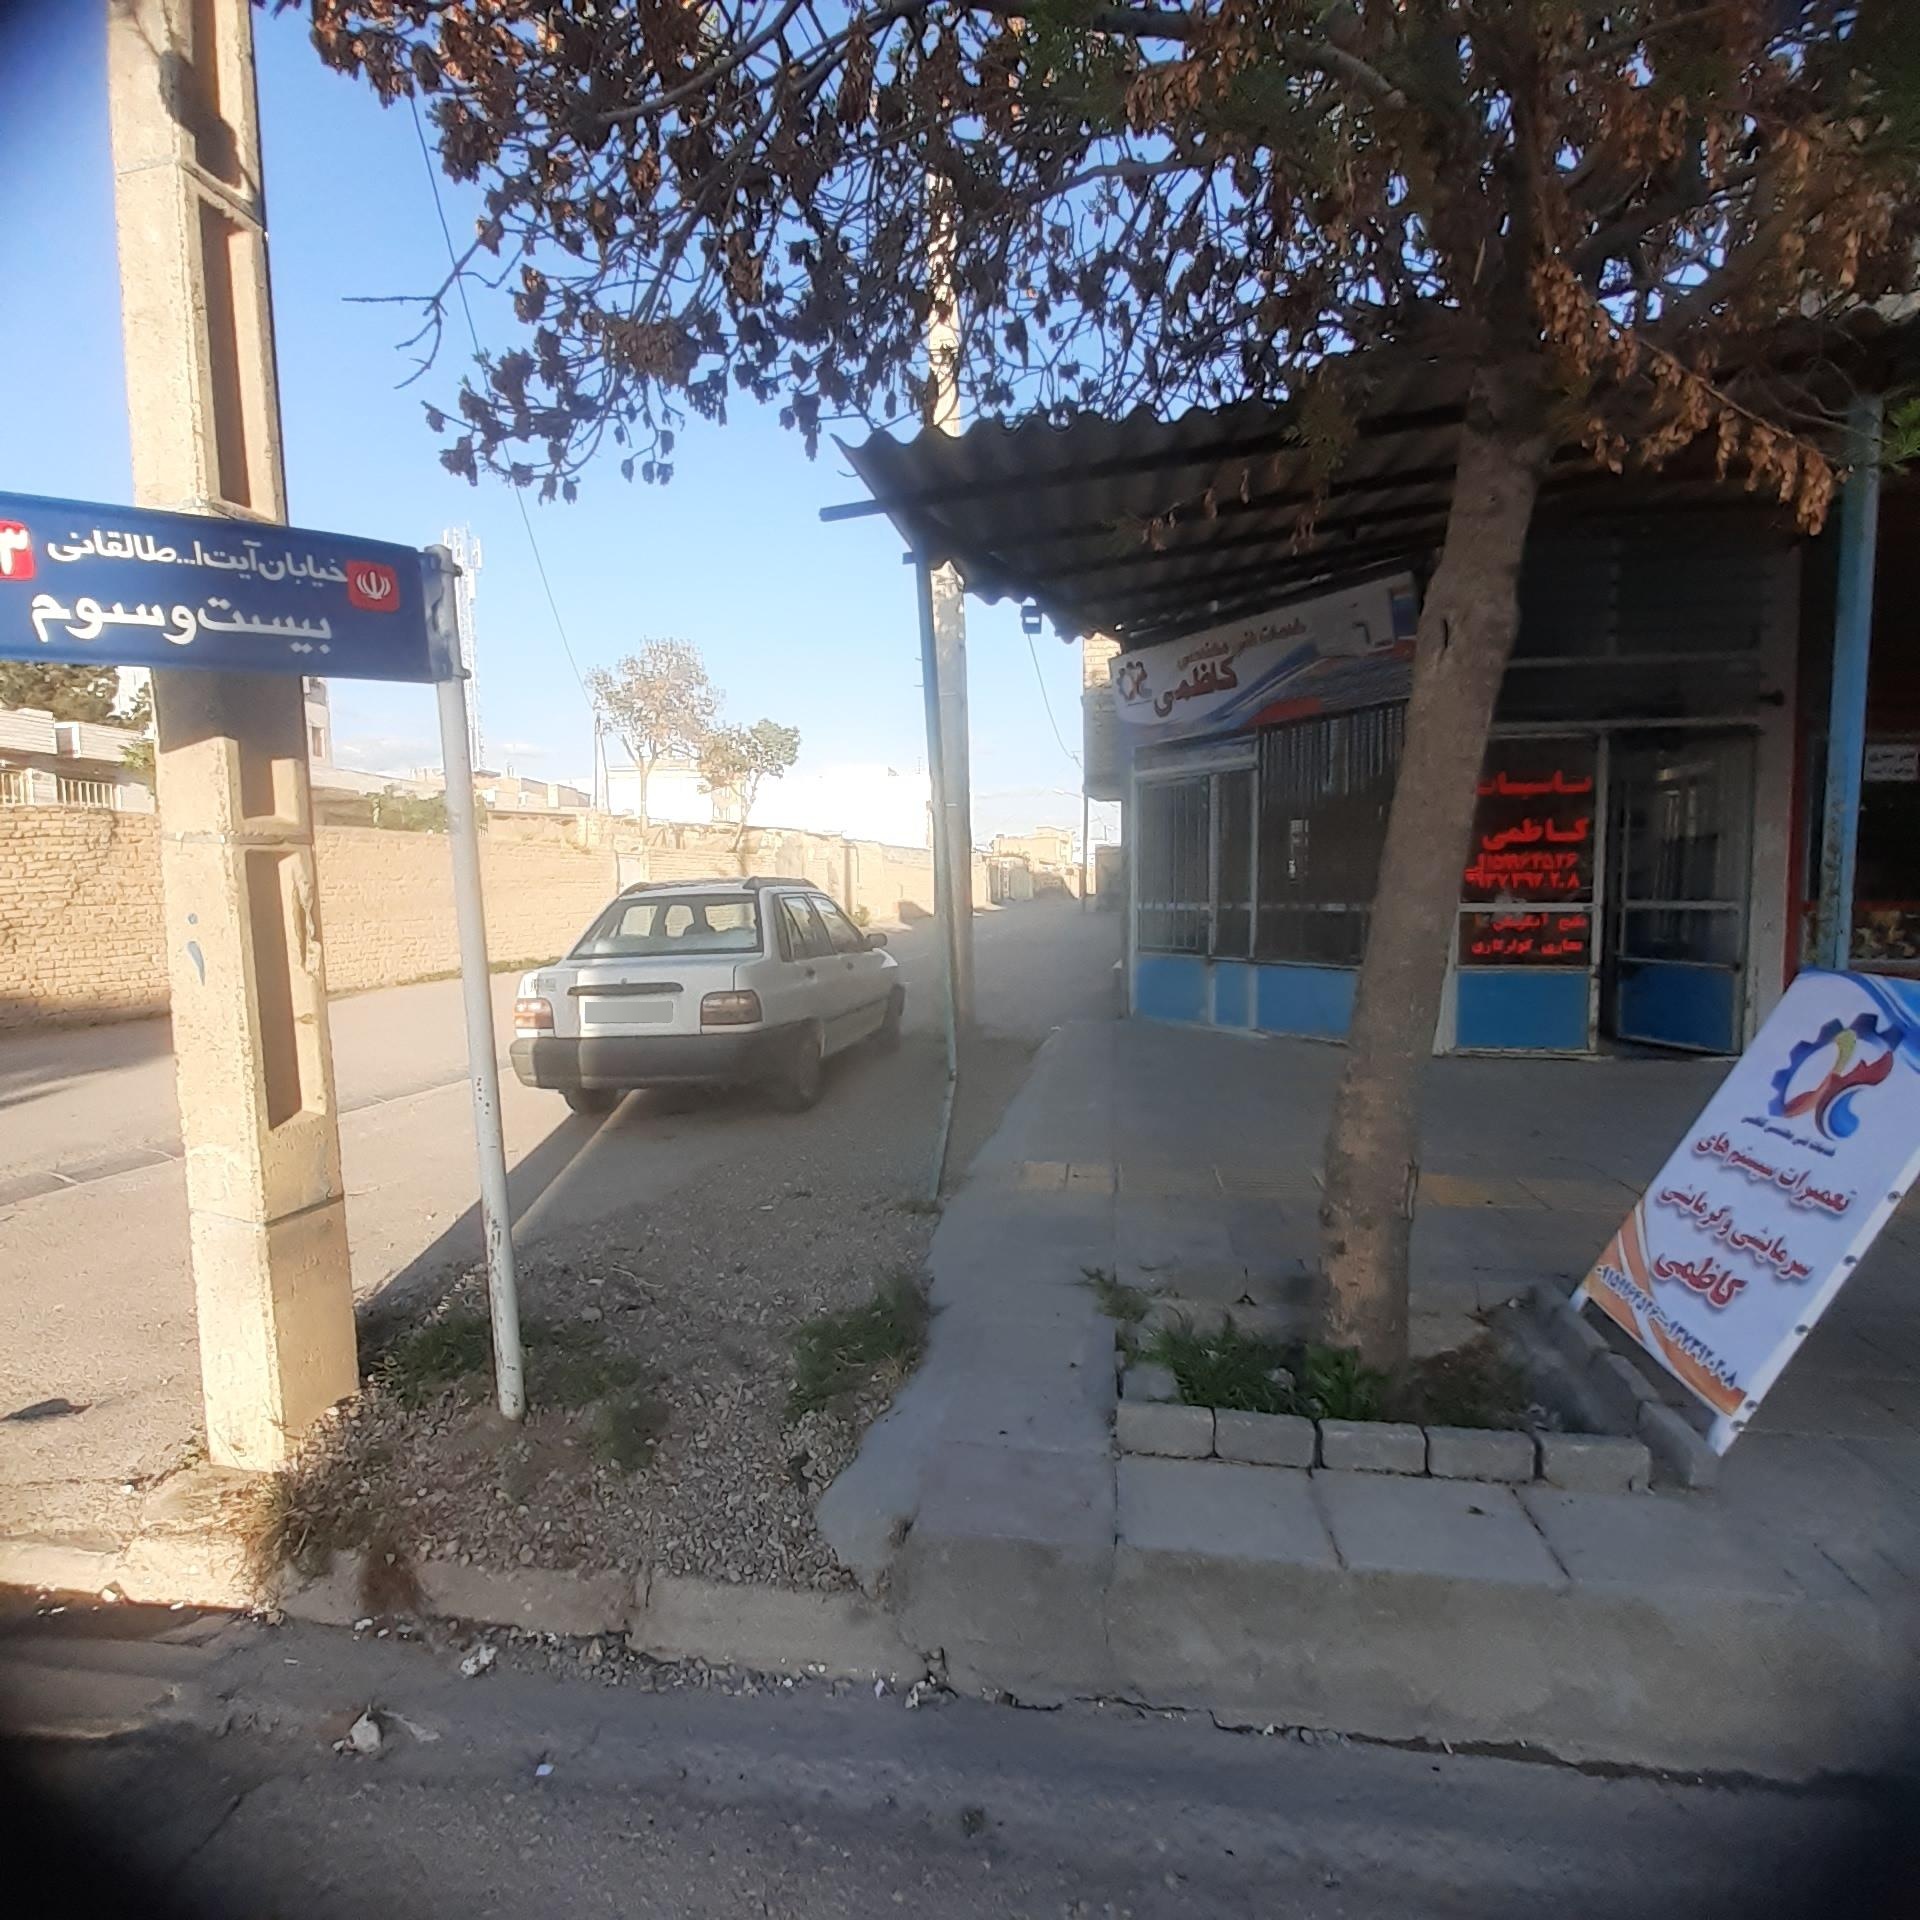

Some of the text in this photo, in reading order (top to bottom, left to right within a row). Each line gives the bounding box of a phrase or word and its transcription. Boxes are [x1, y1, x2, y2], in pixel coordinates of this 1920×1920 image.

[47, 527, 178, 562] طالقانی
[257, 551, 348, 587] خیابان
[31, 593, 333, 655] بیست و سوم
[1153, 655, 1239, 719] کاظمی
[1778, 1167, 1857, 1213] تعمیرات
[1653, 1252, 1749, 1306] کاظمی
